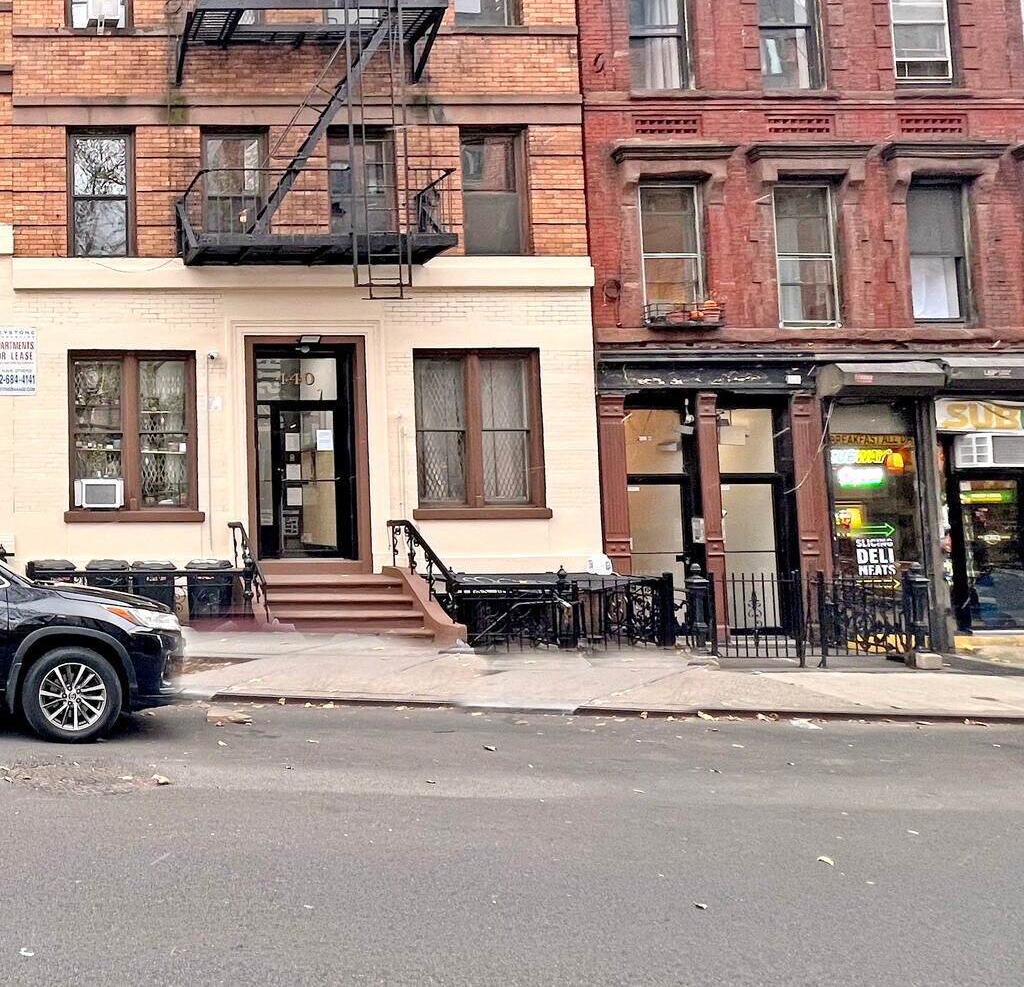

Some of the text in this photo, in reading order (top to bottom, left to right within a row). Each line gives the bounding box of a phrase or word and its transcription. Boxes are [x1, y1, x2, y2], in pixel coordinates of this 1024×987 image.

[11, 352, 33, 360] LEASE
[276, 372, 316, 385] 440
[941, 403, 1024, 429] SUB
[831, 435, 914, 445] BREAKFAST ALL DA
[830, 448, 893, 464] SUBWAY
[856, 538, 893, 548] SLICING
[856, 548, 895, 564] DELI
[858, 565, 896, 576] MEATS
